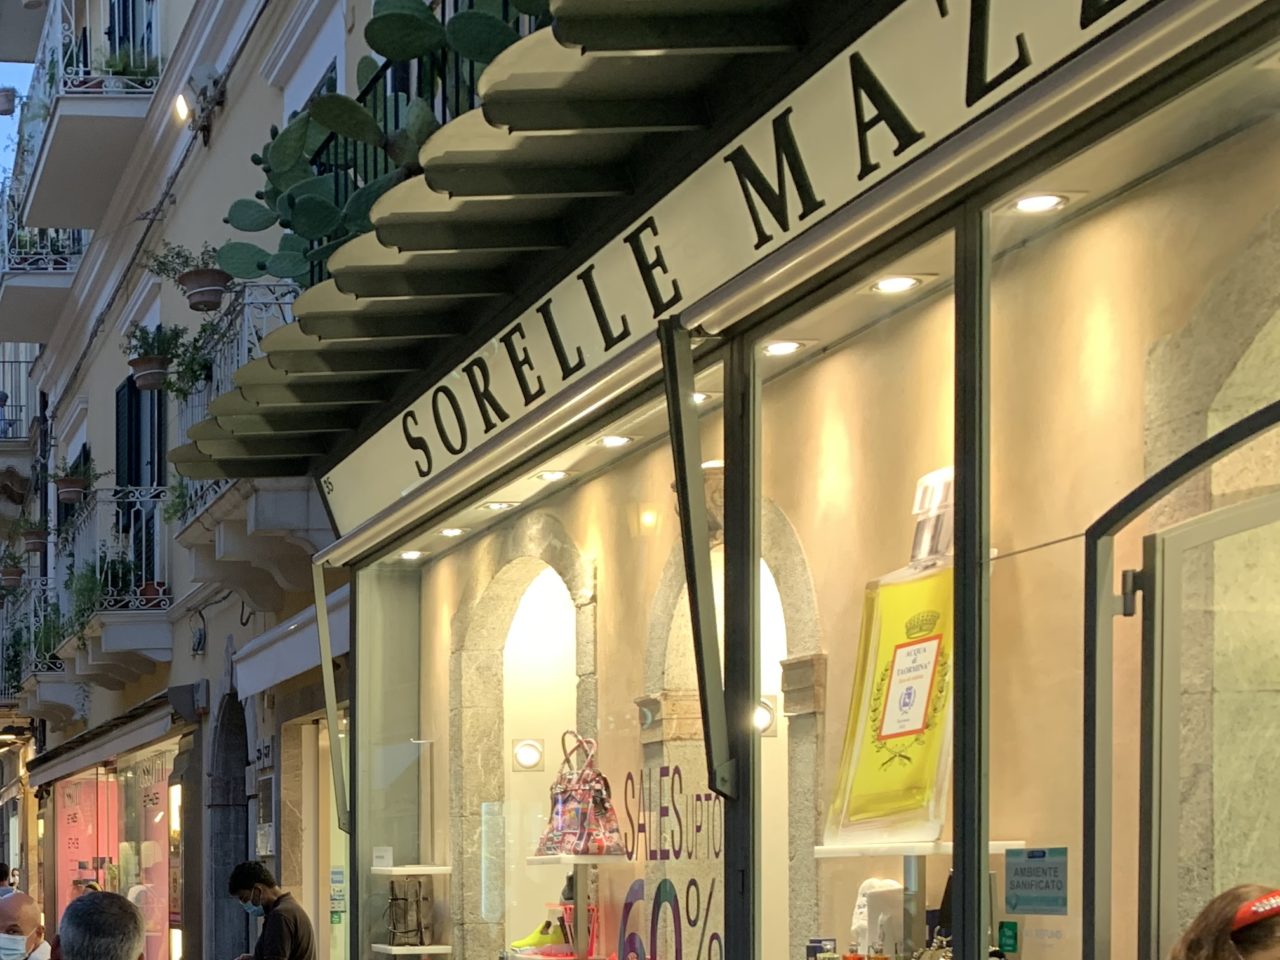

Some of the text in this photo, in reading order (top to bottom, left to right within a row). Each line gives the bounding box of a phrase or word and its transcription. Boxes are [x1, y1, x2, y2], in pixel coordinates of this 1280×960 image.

[402, 0, 1130, 478] SORELLE MAZ
[906, 647, 927, 657] ACQUA
[624, 765, 683, 861] SALES
[1013, 866, 1059, 878] AMBIENTE
[1009, 880, 1063, 891] SANIFICATO
